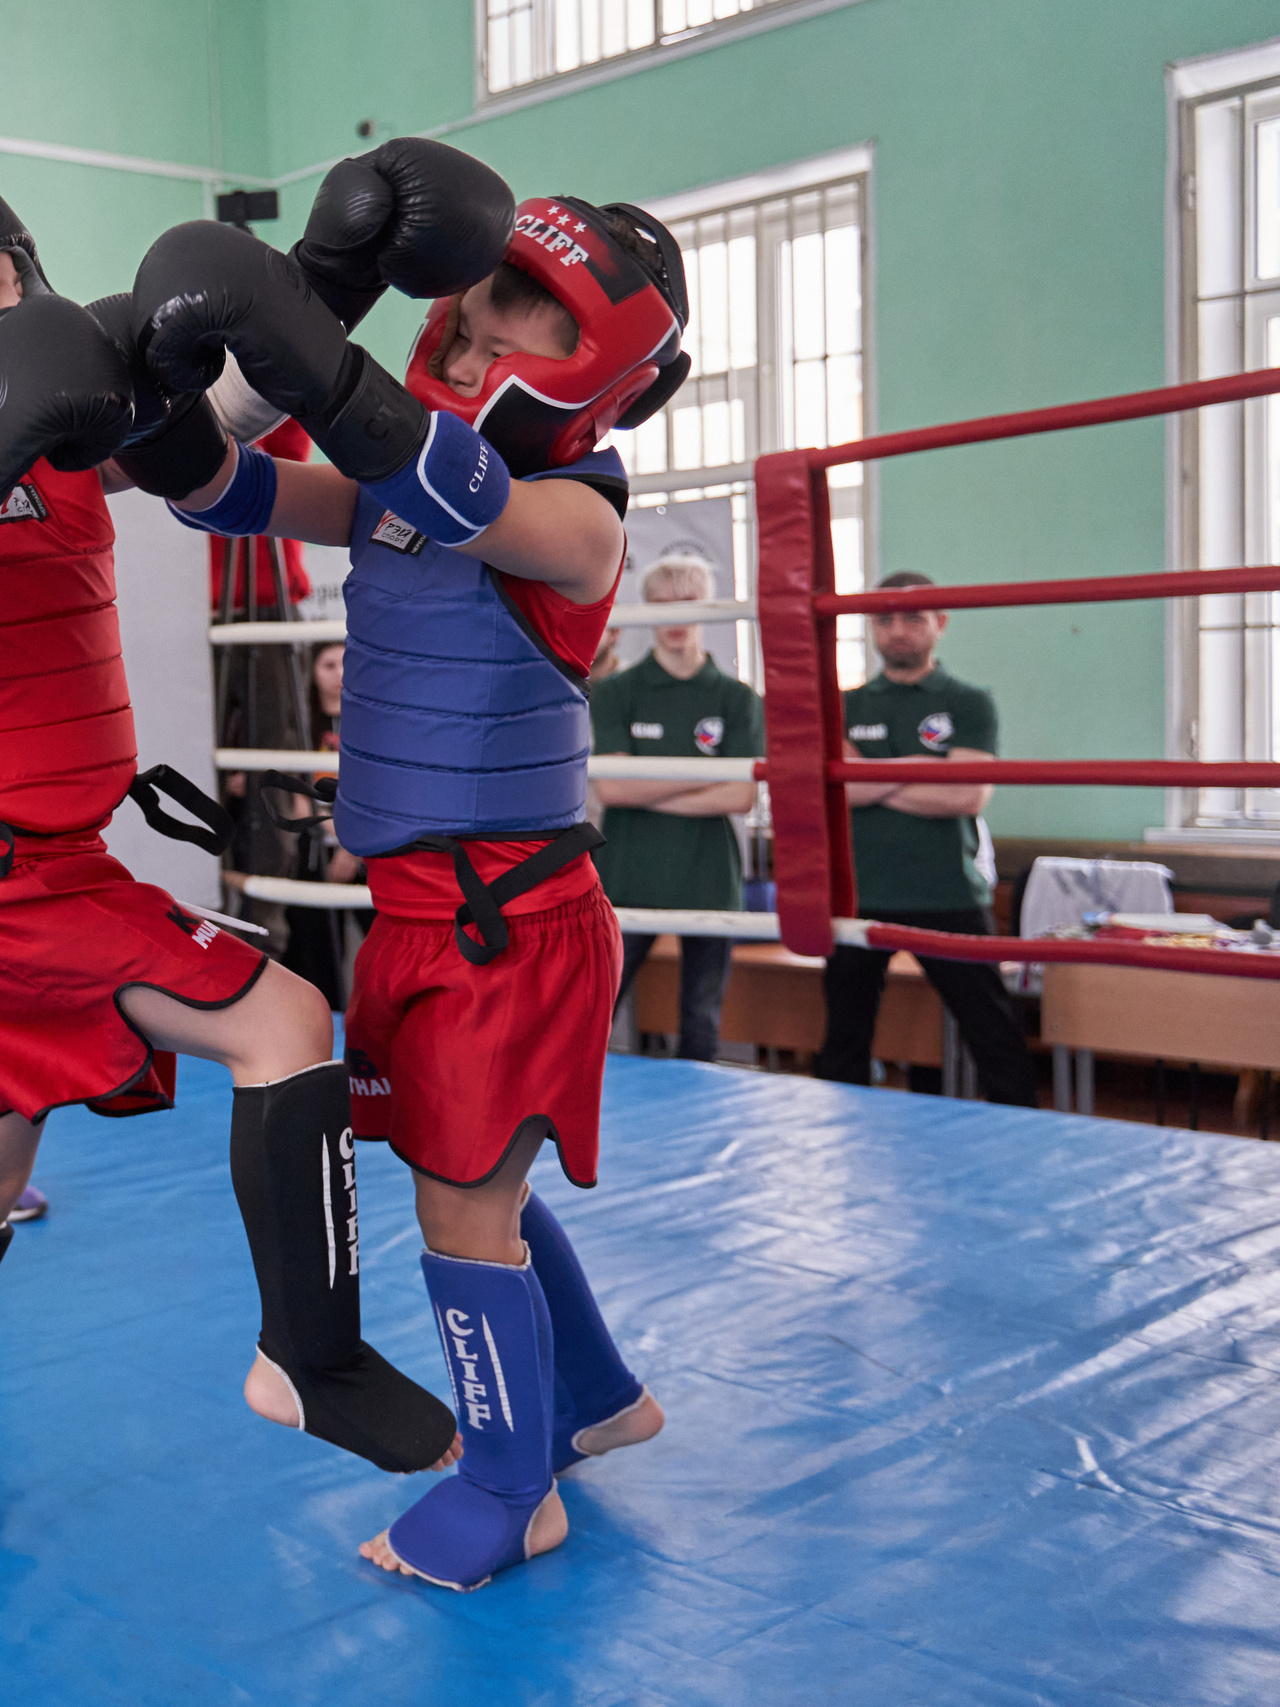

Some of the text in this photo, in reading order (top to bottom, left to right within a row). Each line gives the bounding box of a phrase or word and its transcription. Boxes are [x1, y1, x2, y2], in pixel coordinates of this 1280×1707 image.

[515, 214, 589, 267] CLIFF
[468, 441, 488, 493] CLIFF
[381, 532, 405, 544] СПОРТ
[384, 522, 412, 539] РЭЙ
[446, 1308, 491, 1430] CLIFF
